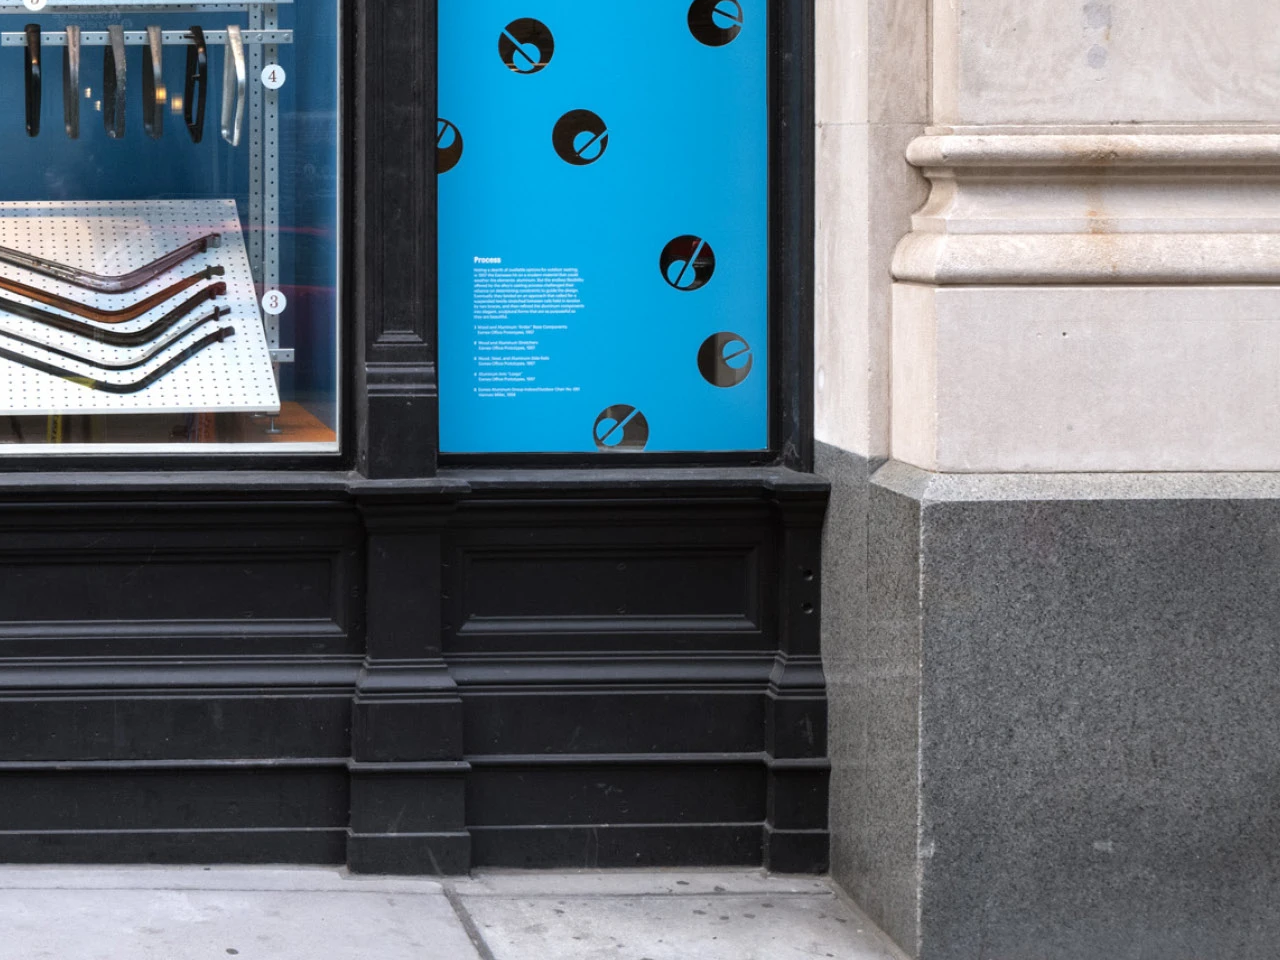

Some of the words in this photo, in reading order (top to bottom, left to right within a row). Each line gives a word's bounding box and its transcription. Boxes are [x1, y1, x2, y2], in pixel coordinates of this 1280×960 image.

[268, 70, 278, 83] 4
[473, 256, 502, 264] Process
[269, 295, 279, 309] 3
